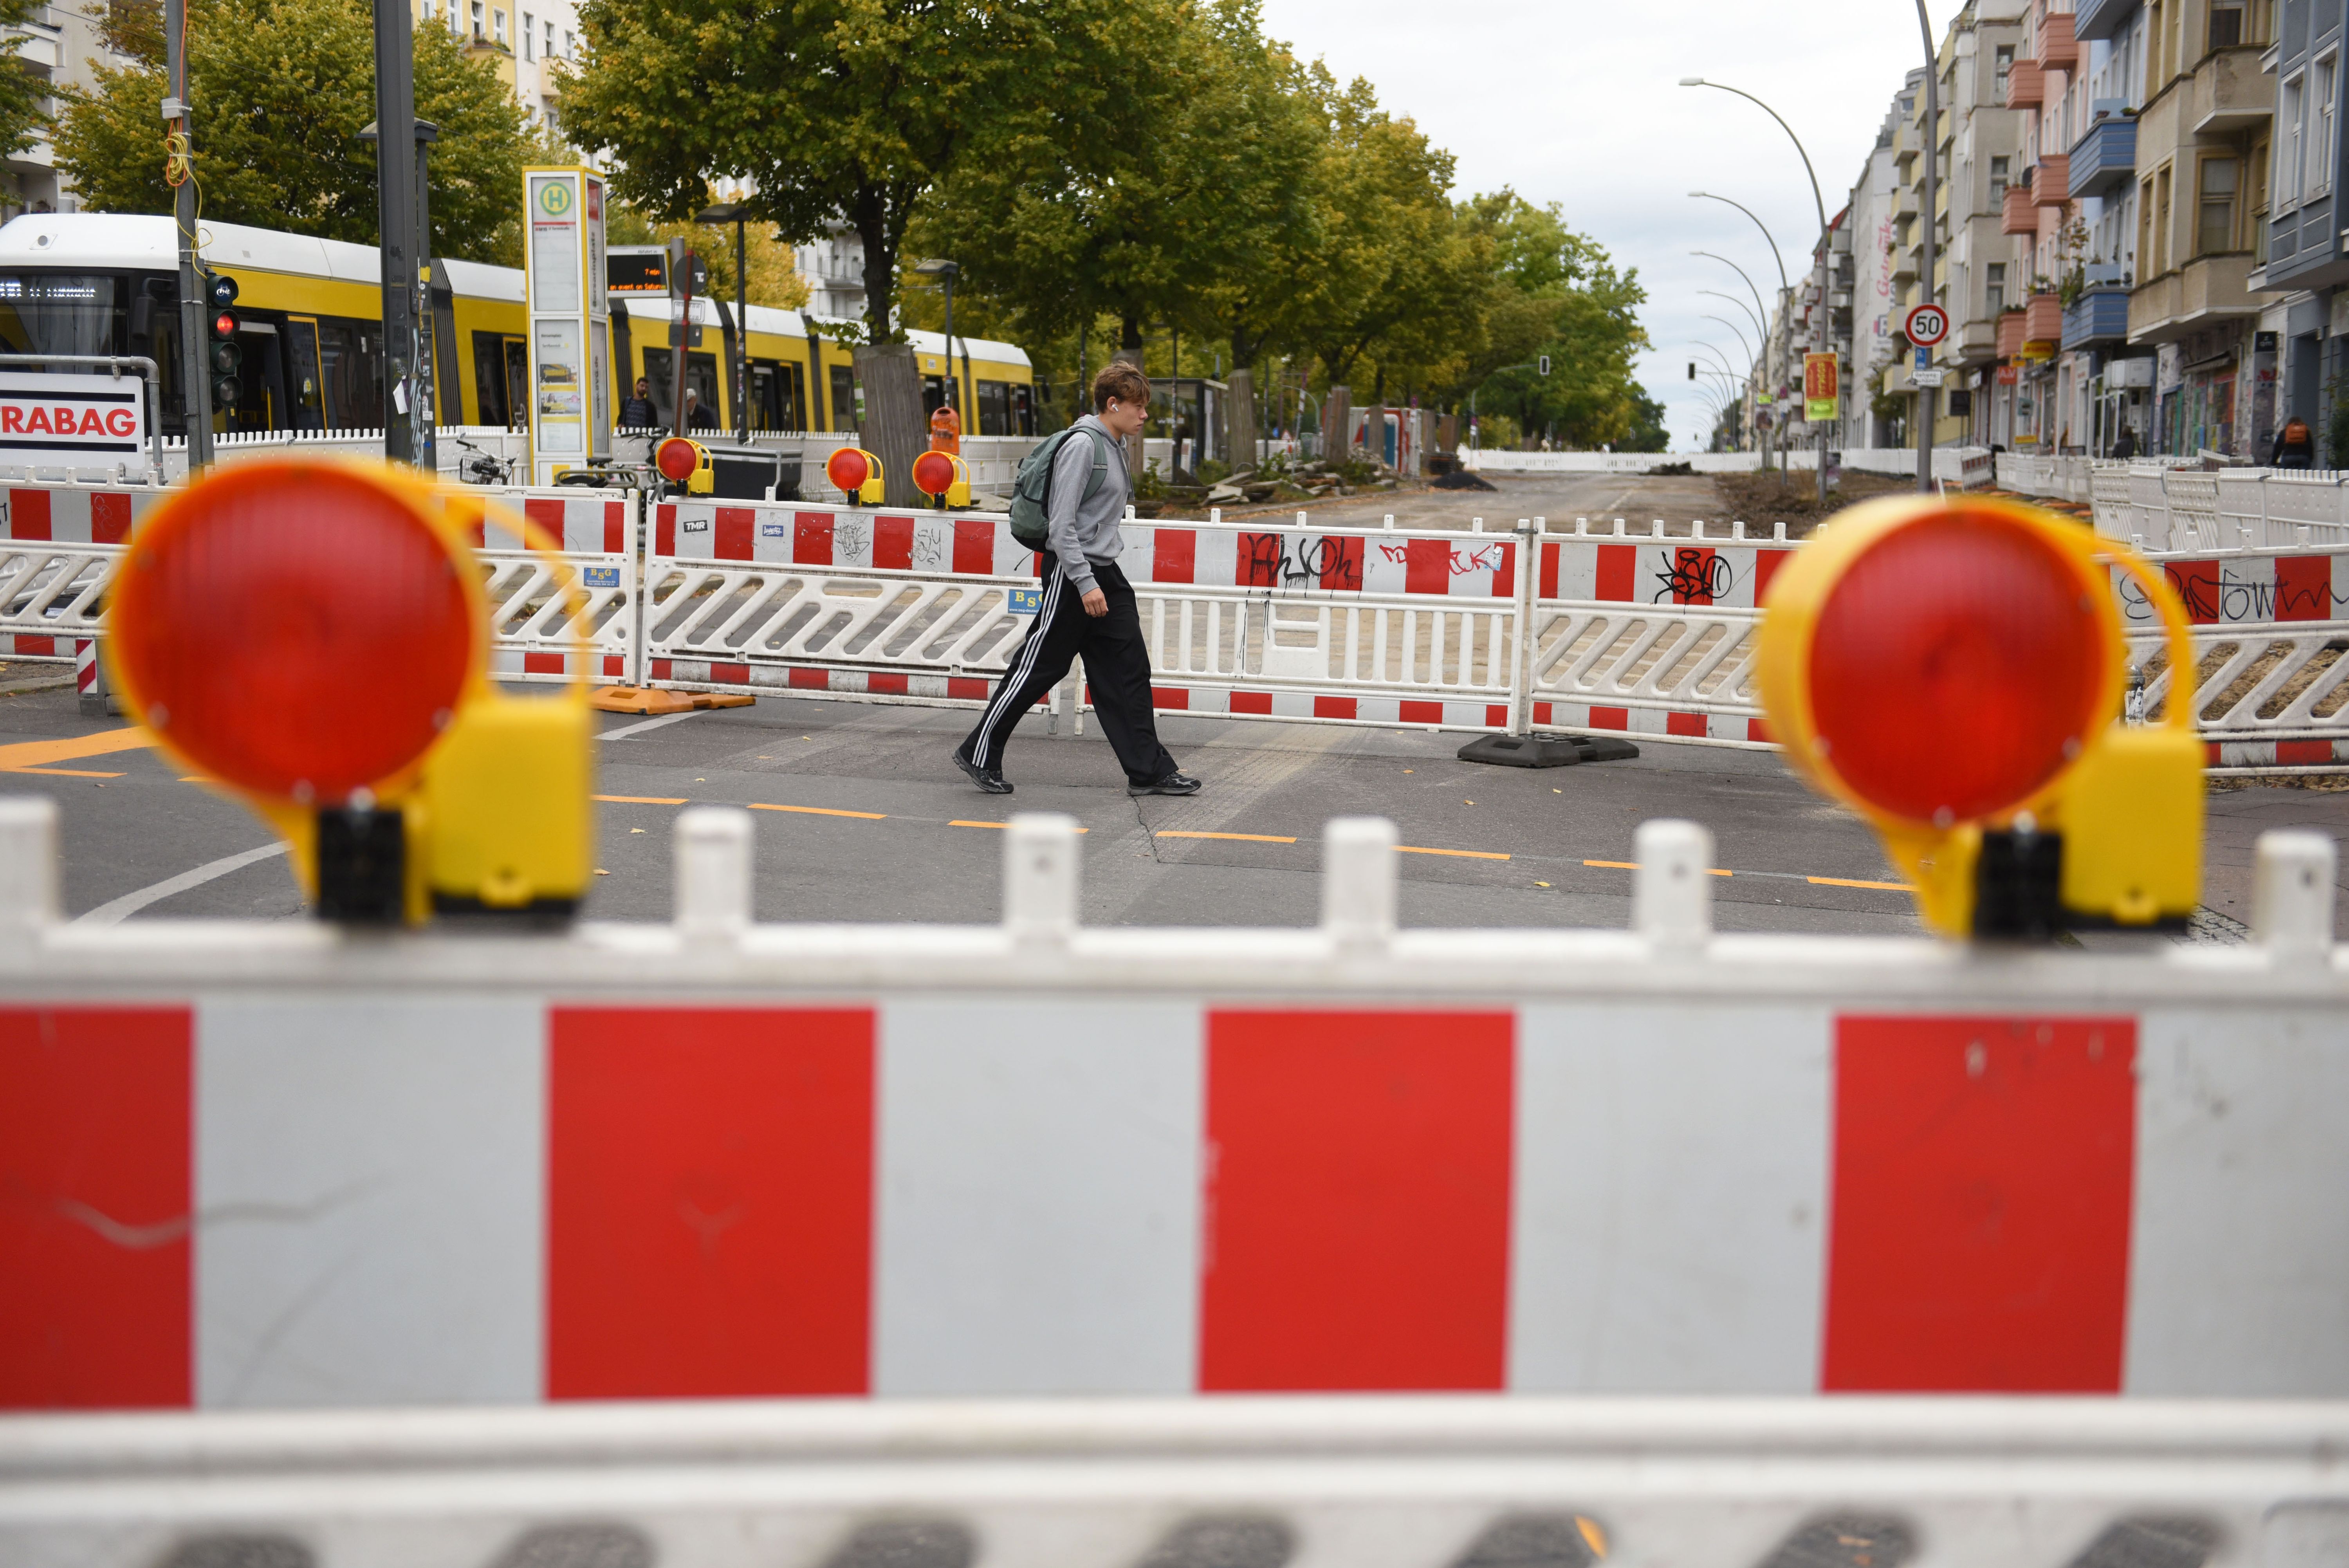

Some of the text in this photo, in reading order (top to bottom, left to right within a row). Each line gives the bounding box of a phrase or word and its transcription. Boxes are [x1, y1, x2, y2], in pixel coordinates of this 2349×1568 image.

[548, 189, 562, 208] H
[1915, 316, 1940, 335] 50
[0, 406, 136, 437] RABAG
[686, 521, 705, 530] TMR
[590, 568, 612, 580] BSG
